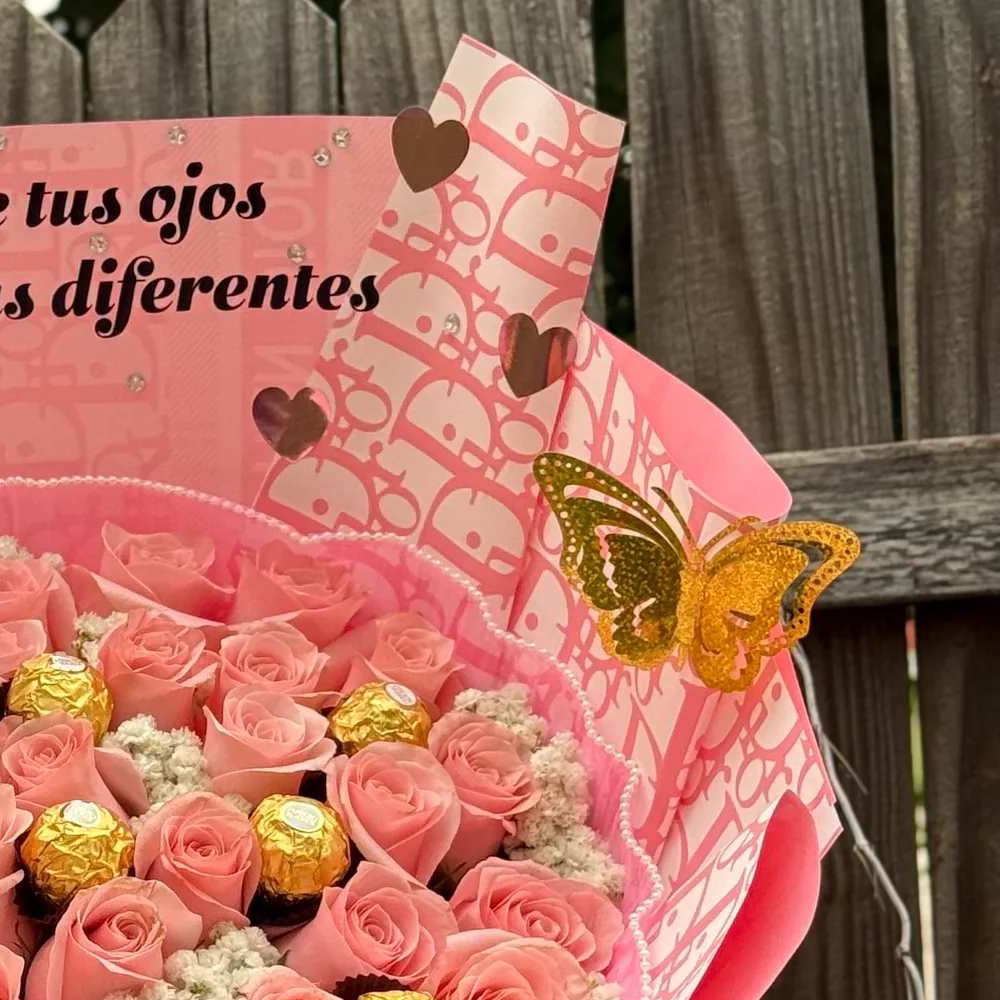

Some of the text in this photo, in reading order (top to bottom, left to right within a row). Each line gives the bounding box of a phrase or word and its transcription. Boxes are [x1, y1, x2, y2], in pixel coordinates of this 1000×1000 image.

[25, 181, 122, 229] tus
[138, 161, 267, 245] ojos
[50, 256, 381, 339] diferentes
